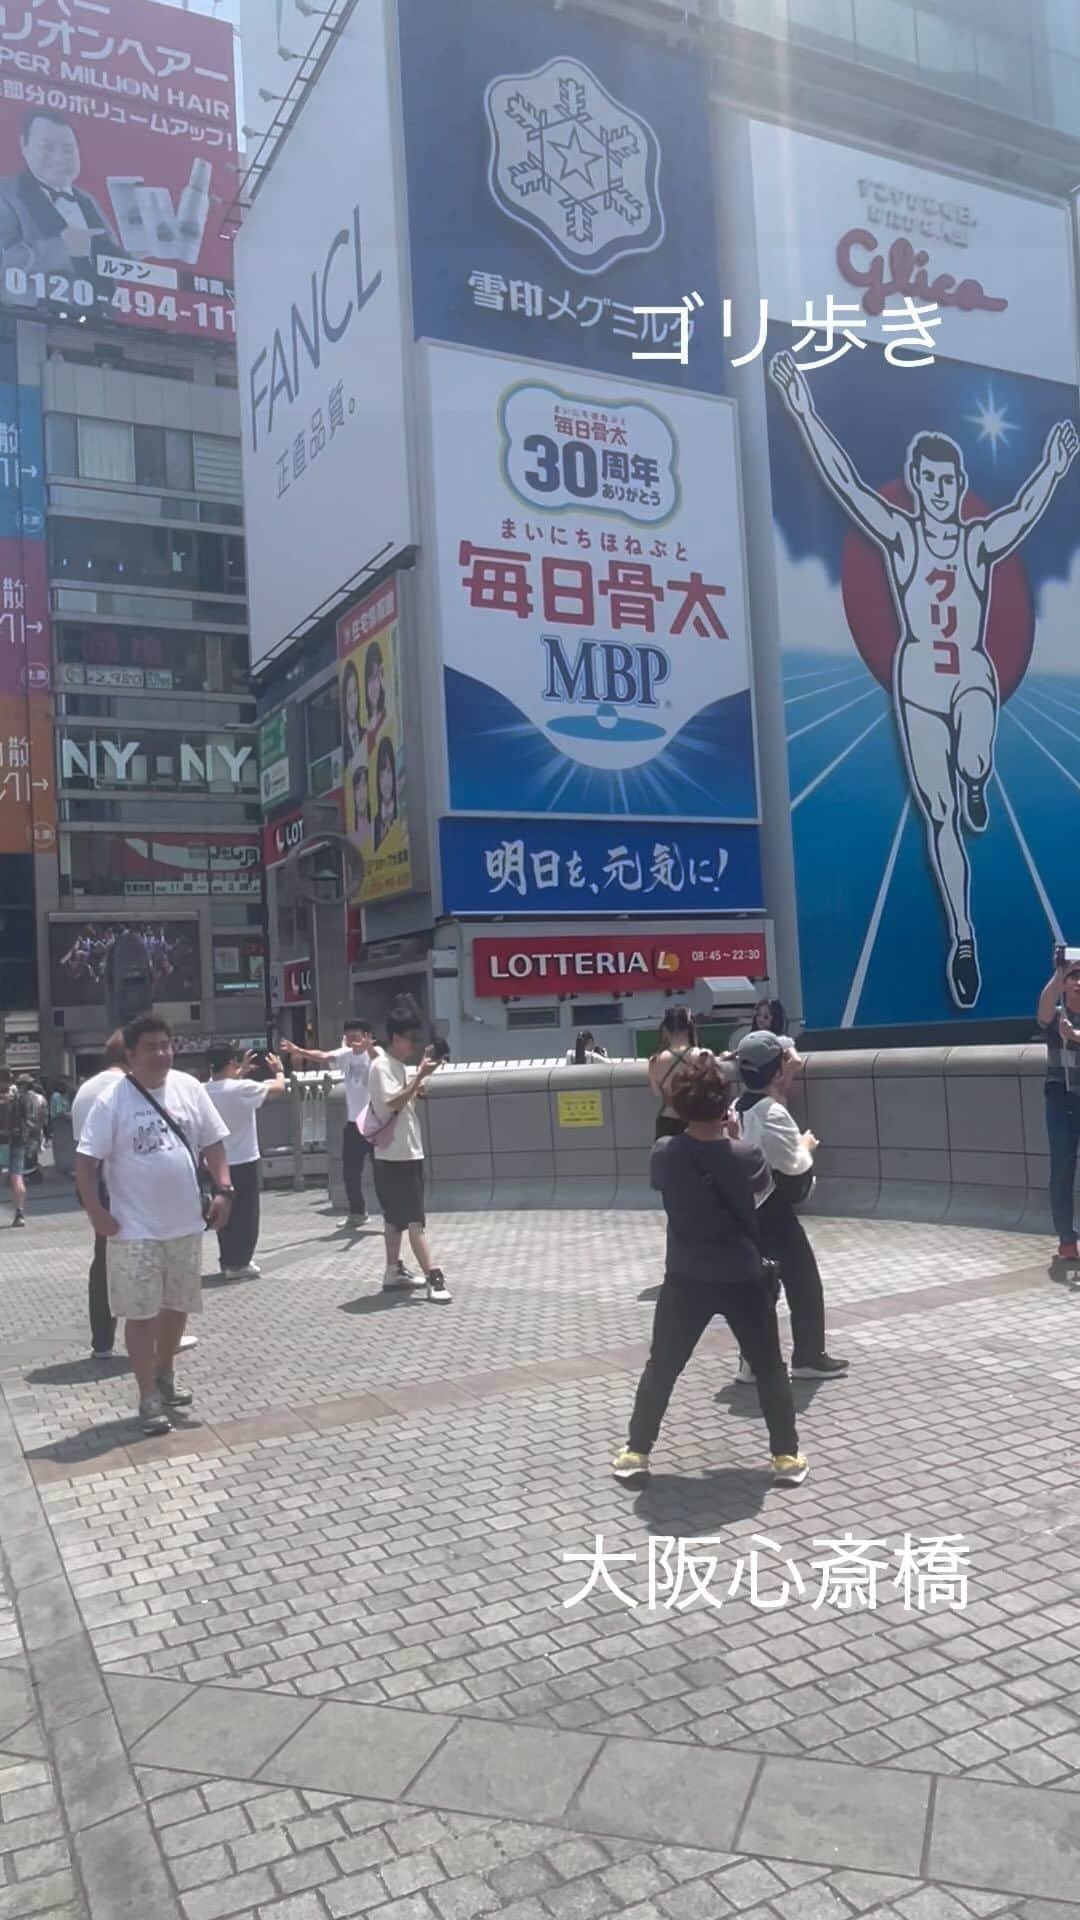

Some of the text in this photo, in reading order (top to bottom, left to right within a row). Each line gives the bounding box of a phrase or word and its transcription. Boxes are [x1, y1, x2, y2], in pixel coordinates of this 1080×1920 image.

[0, 79, 233, 152] 部分のボリュームアップ!
[60, 61, 160, 104] MILLION
[168, 87, 230, 120] HAIR
[102, 258, 151, 279] ルアン
[836, 228, 1008, 316] Glico
[250, 204, 382, 453] FANCL
[468, 270, 694, 347] 雪印メグミルク
[553, 415, 628, 447] 毎日骨太
[601, 483, 661, 507] ありがとう
[501, 517, 689, 562] まいにちほねぶと
[459, 540, 729, 640] 毎日骨太
[925, 564, 960, 675] グリコ
[541, 634, 671, 708] MBP
[61, 739, 140, 779] NY
[180, 743, 252, 783] NY
[484, 839, 729, 896] 明日を、元気に!
[490, 951, 648, 978] LOTTERIA
